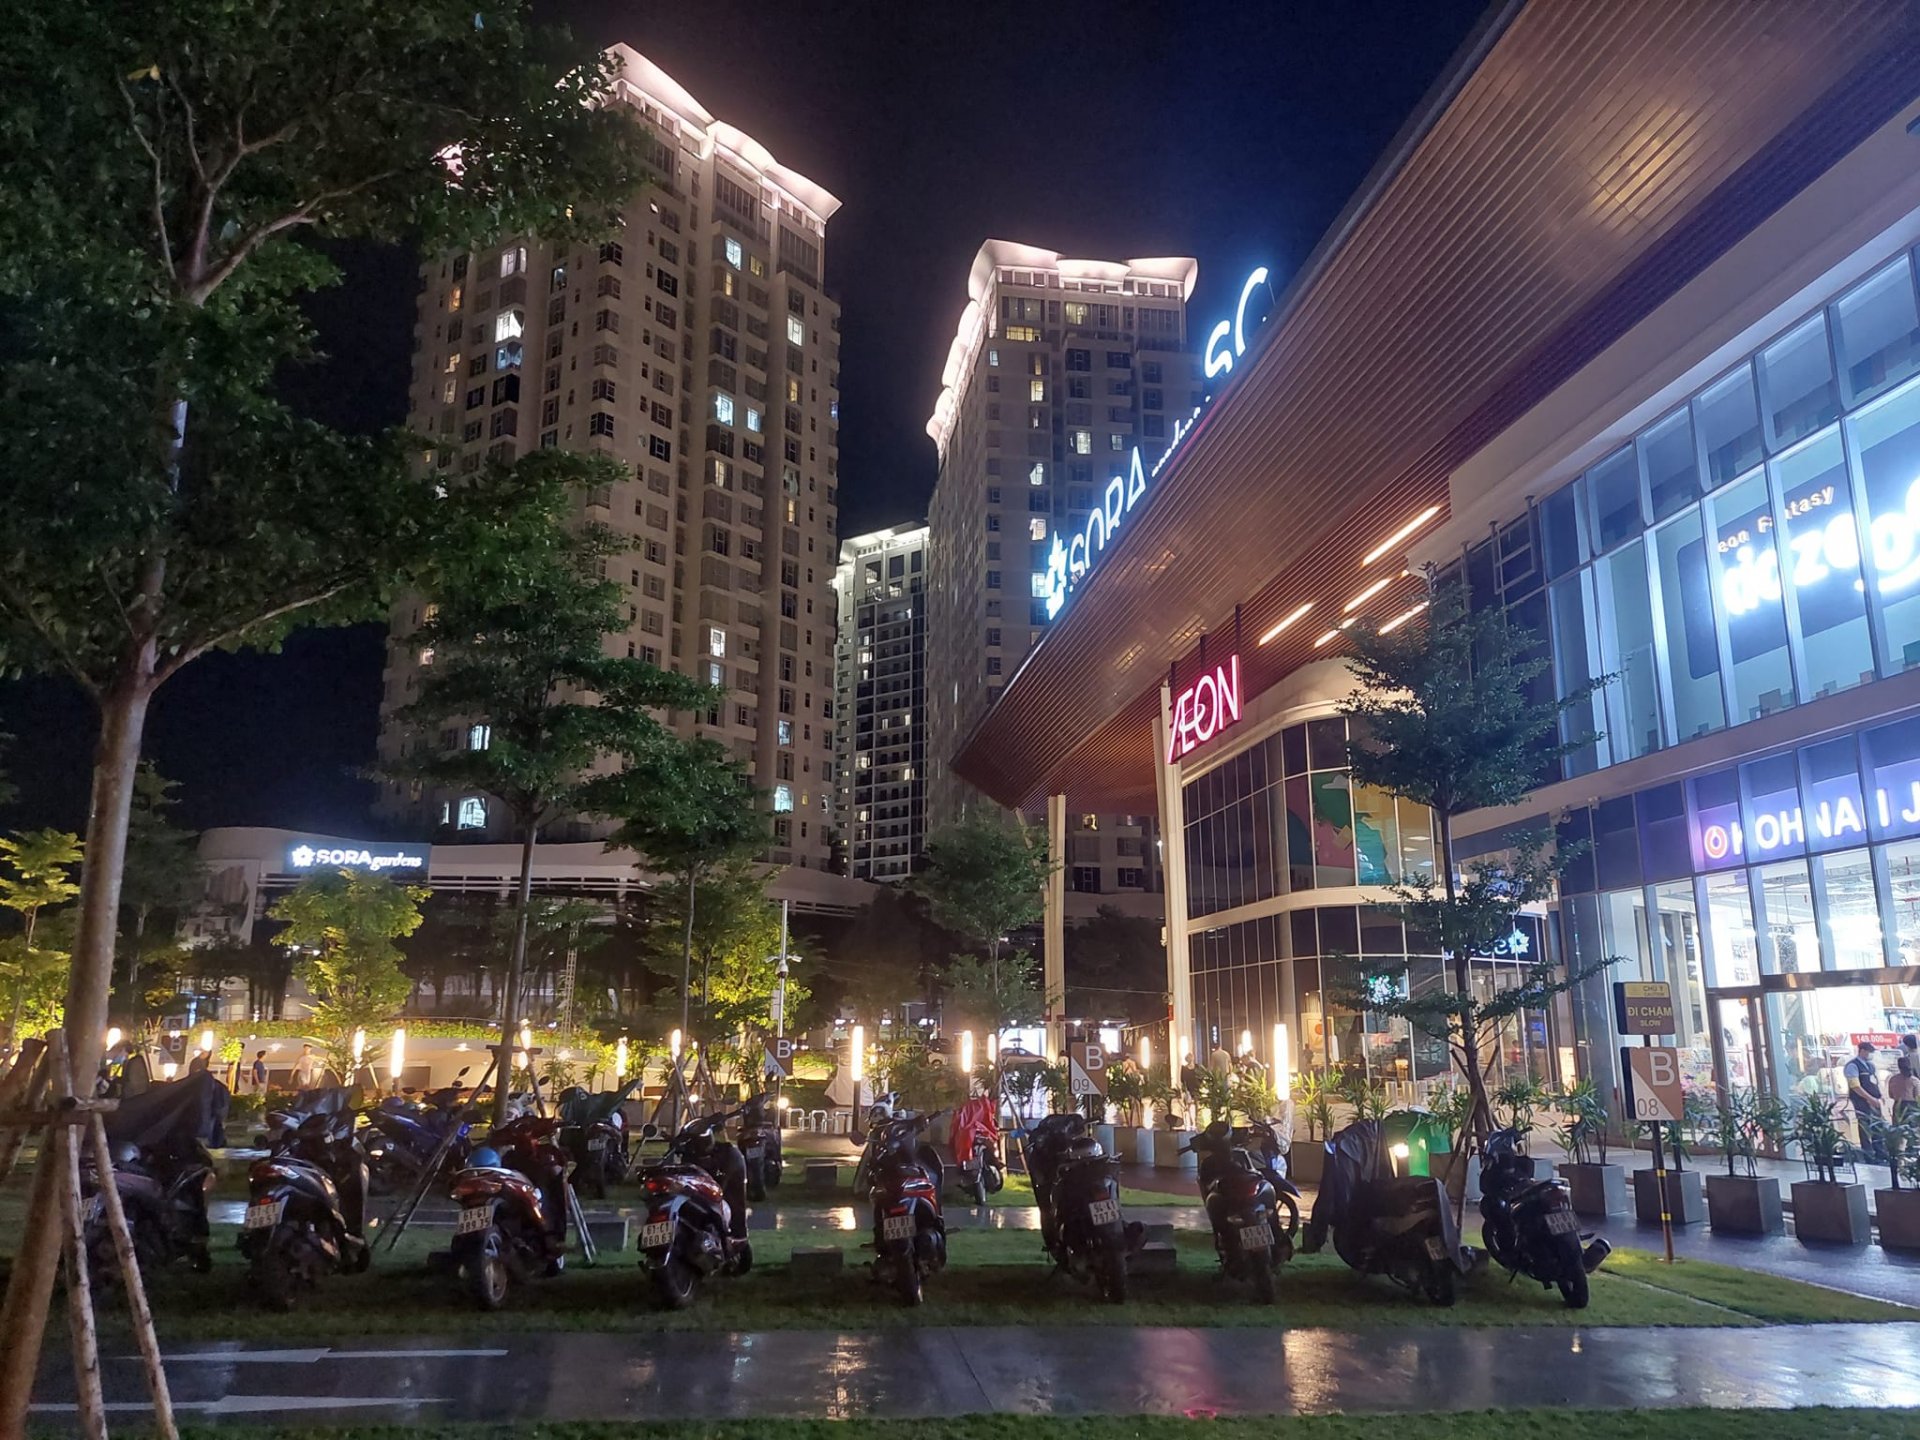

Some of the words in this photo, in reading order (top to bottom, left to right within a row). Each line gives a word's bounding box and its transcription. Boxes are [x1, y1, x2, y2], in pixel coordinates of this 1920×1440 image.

[1717, 529, 1750, 554] eon
[315, 848, 372, 865] SORA
[370, 851, 423, 871] gardens
[776, 1039, 792, 1059] B
[1085, 1045, 1104, 1070] B
[1649, 1051, 1675, 1086] B
[1072, 1078, 1090, 1092] 09
[1636, 1098, 1659, 1117] 08
